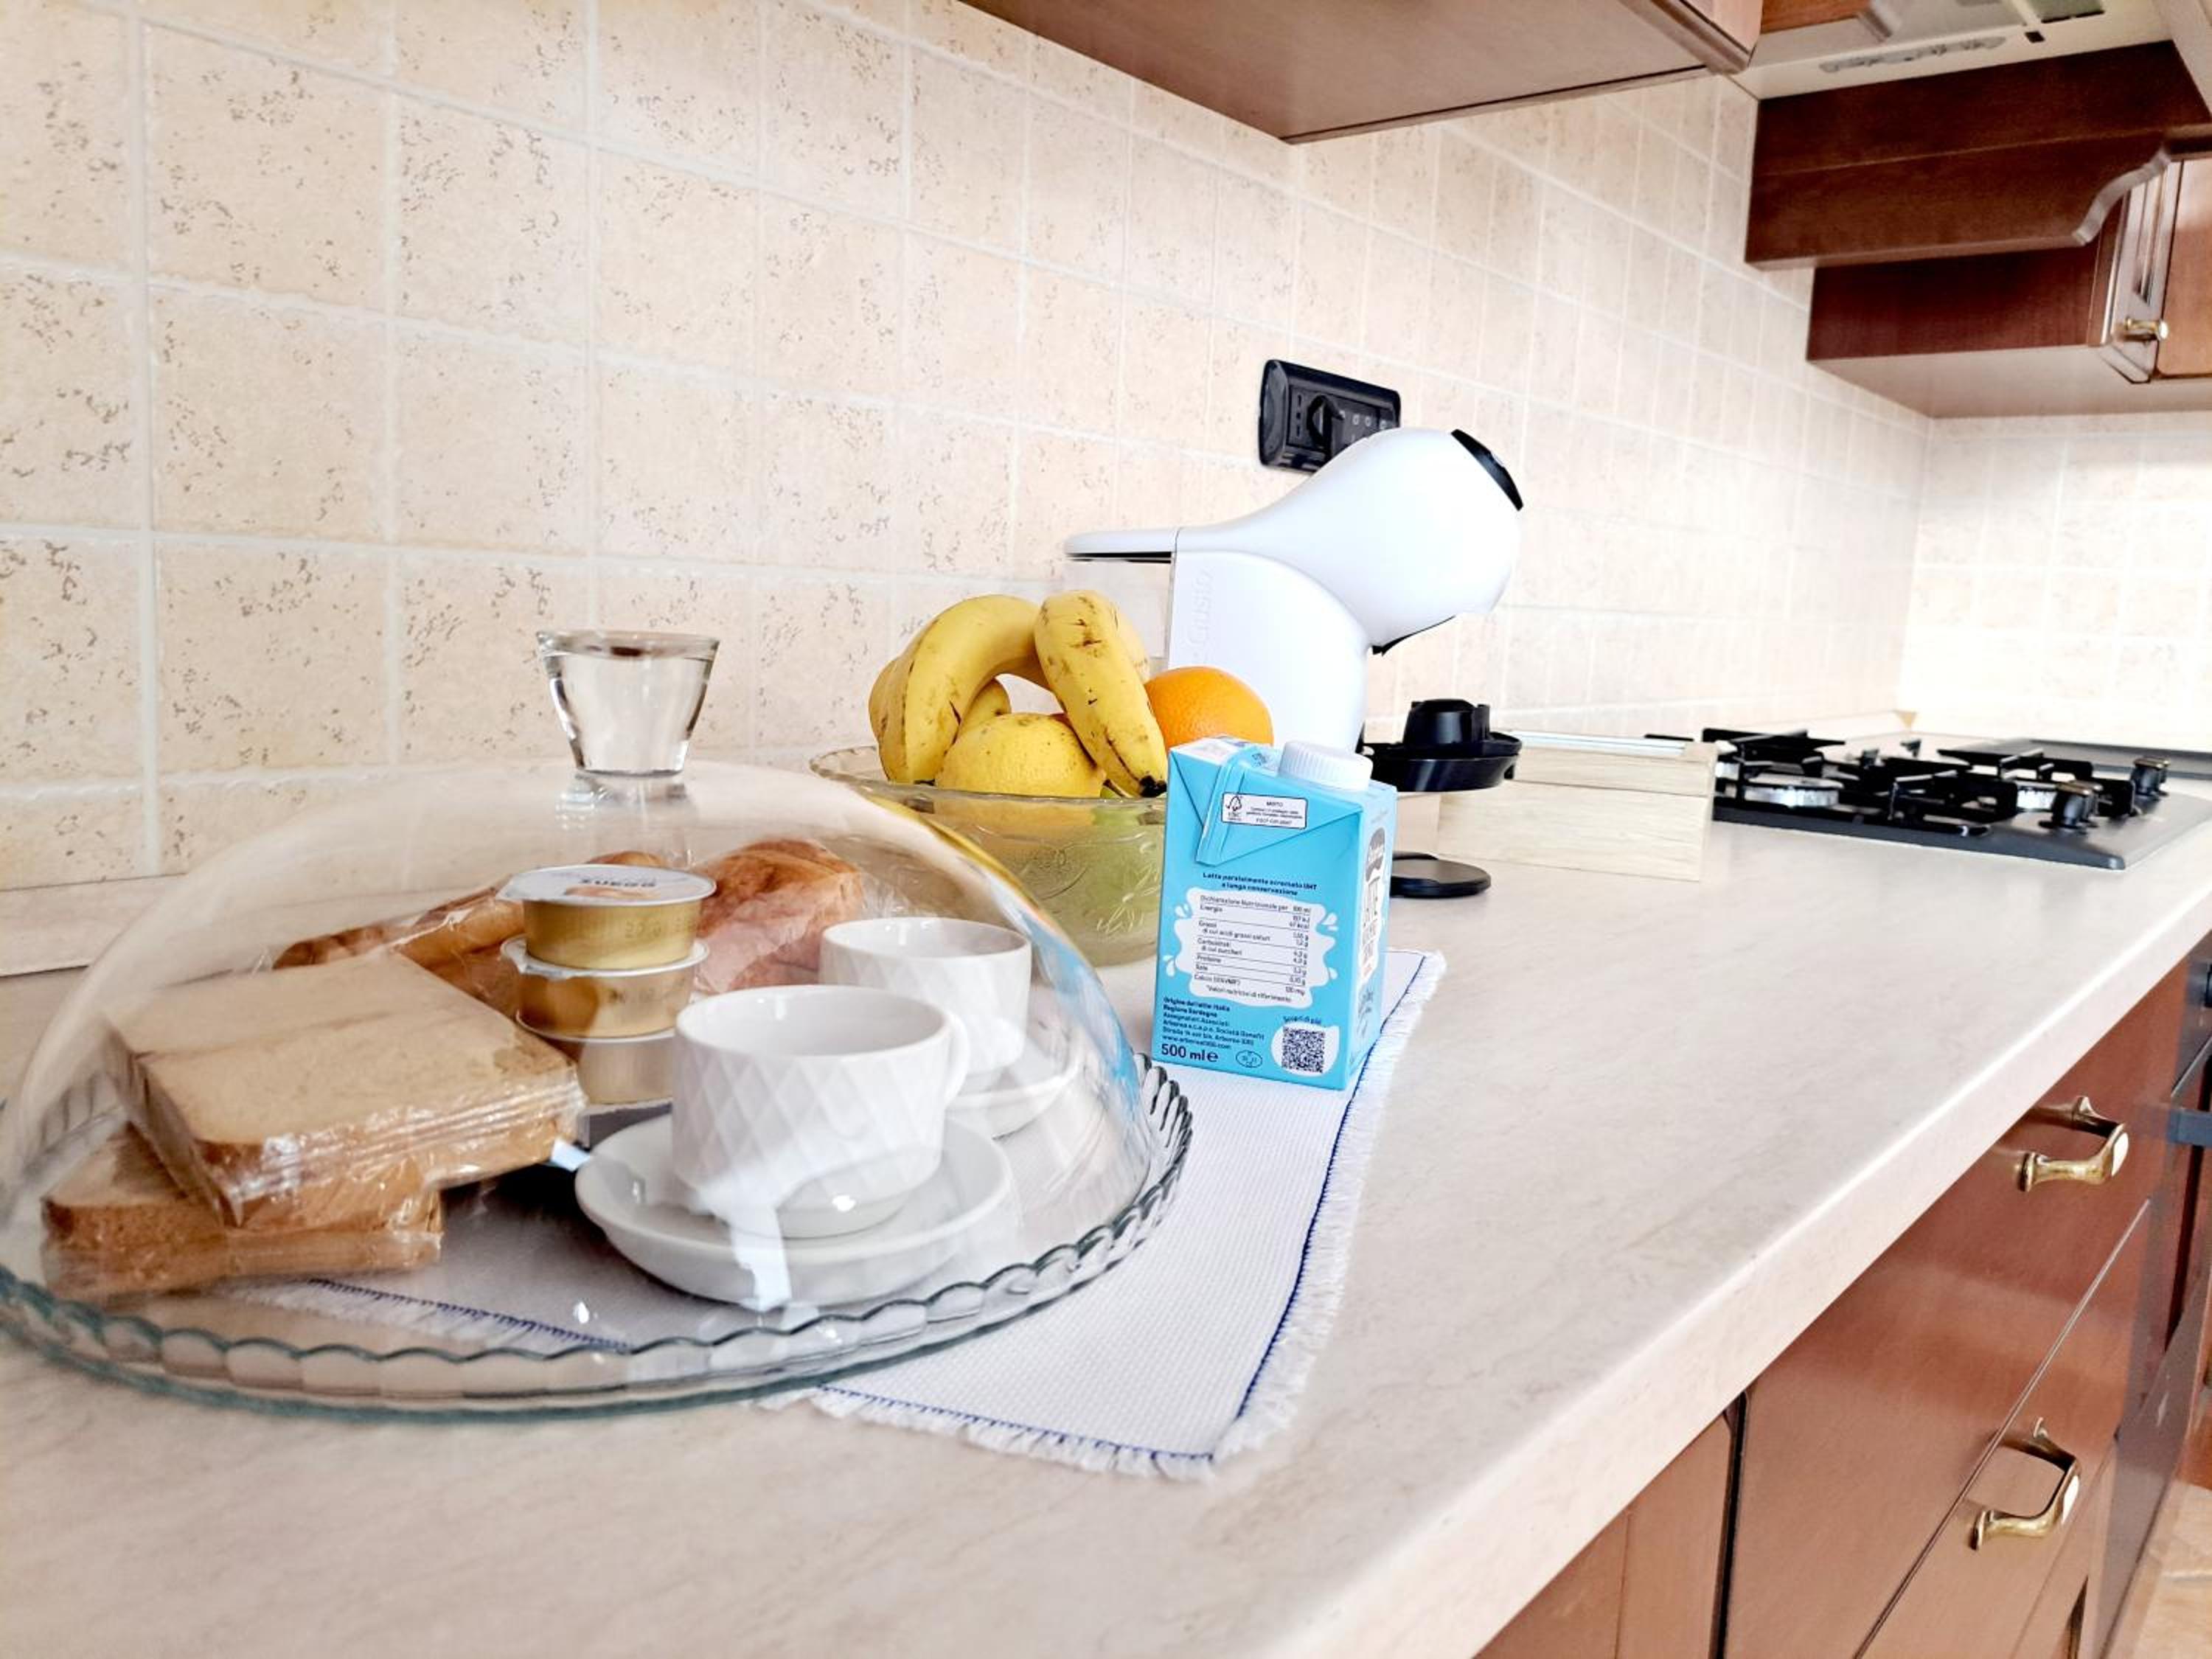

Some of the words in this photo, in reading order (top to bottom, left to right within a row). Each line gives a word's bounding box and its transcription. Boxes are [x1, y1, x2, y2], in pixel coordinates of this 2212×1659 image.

[1222, 874, 1268, 885] parzialmente
[1270, 880, 1302, 888] scremato
[1227, 882, 1247, 891] lunga
[1248, 886, 1298, 896] conservazione
[1200, 895, 1240, 905] Dichiarazione
[1200, 905, 1223, 913] Energia
[1257, 992, 1291, 1001] riferimento
[1164, 997, 1185, 1006] Origine
[1214, 1004, 1230, 1012] Italia
[1164, 1004, 1187, 1013] Regione
[1189, 1007, 1217, 1018] Sardegna
[1161, 1043, 1186, 1058] 500
